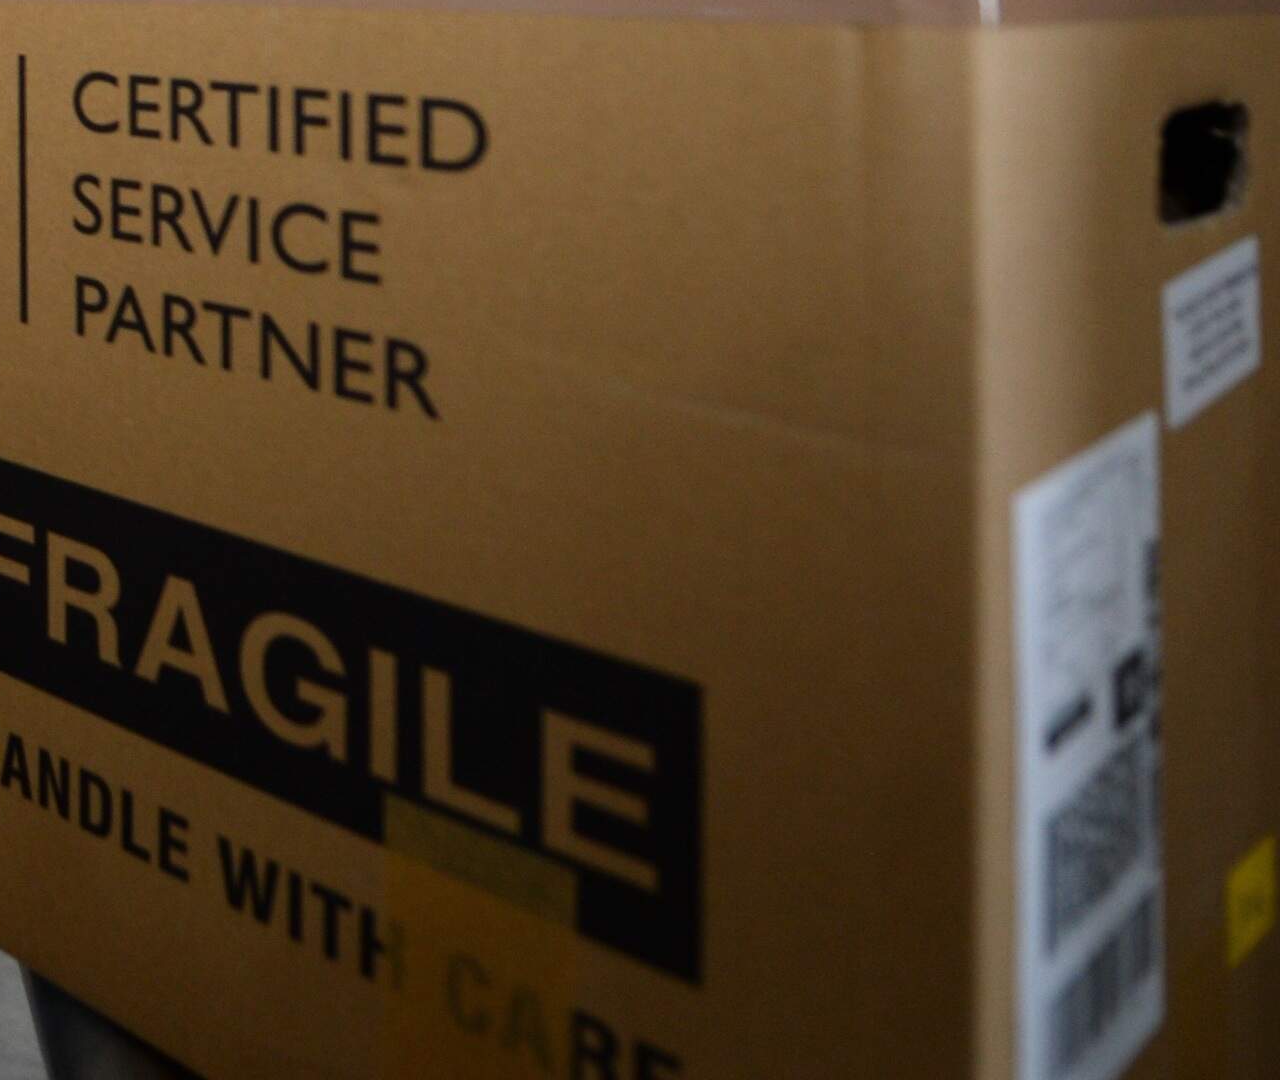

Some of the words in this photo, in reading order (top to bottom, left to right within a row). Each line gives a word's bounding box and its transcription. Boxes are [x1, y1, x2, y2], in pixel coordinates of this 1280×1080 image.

[72, 70, 489, 174] CERTIFIED
[72, 173, 383, 286] SERVICE
[73, 275, 441, 420] PARTNER
[217, 834, 407, 990] WITH
